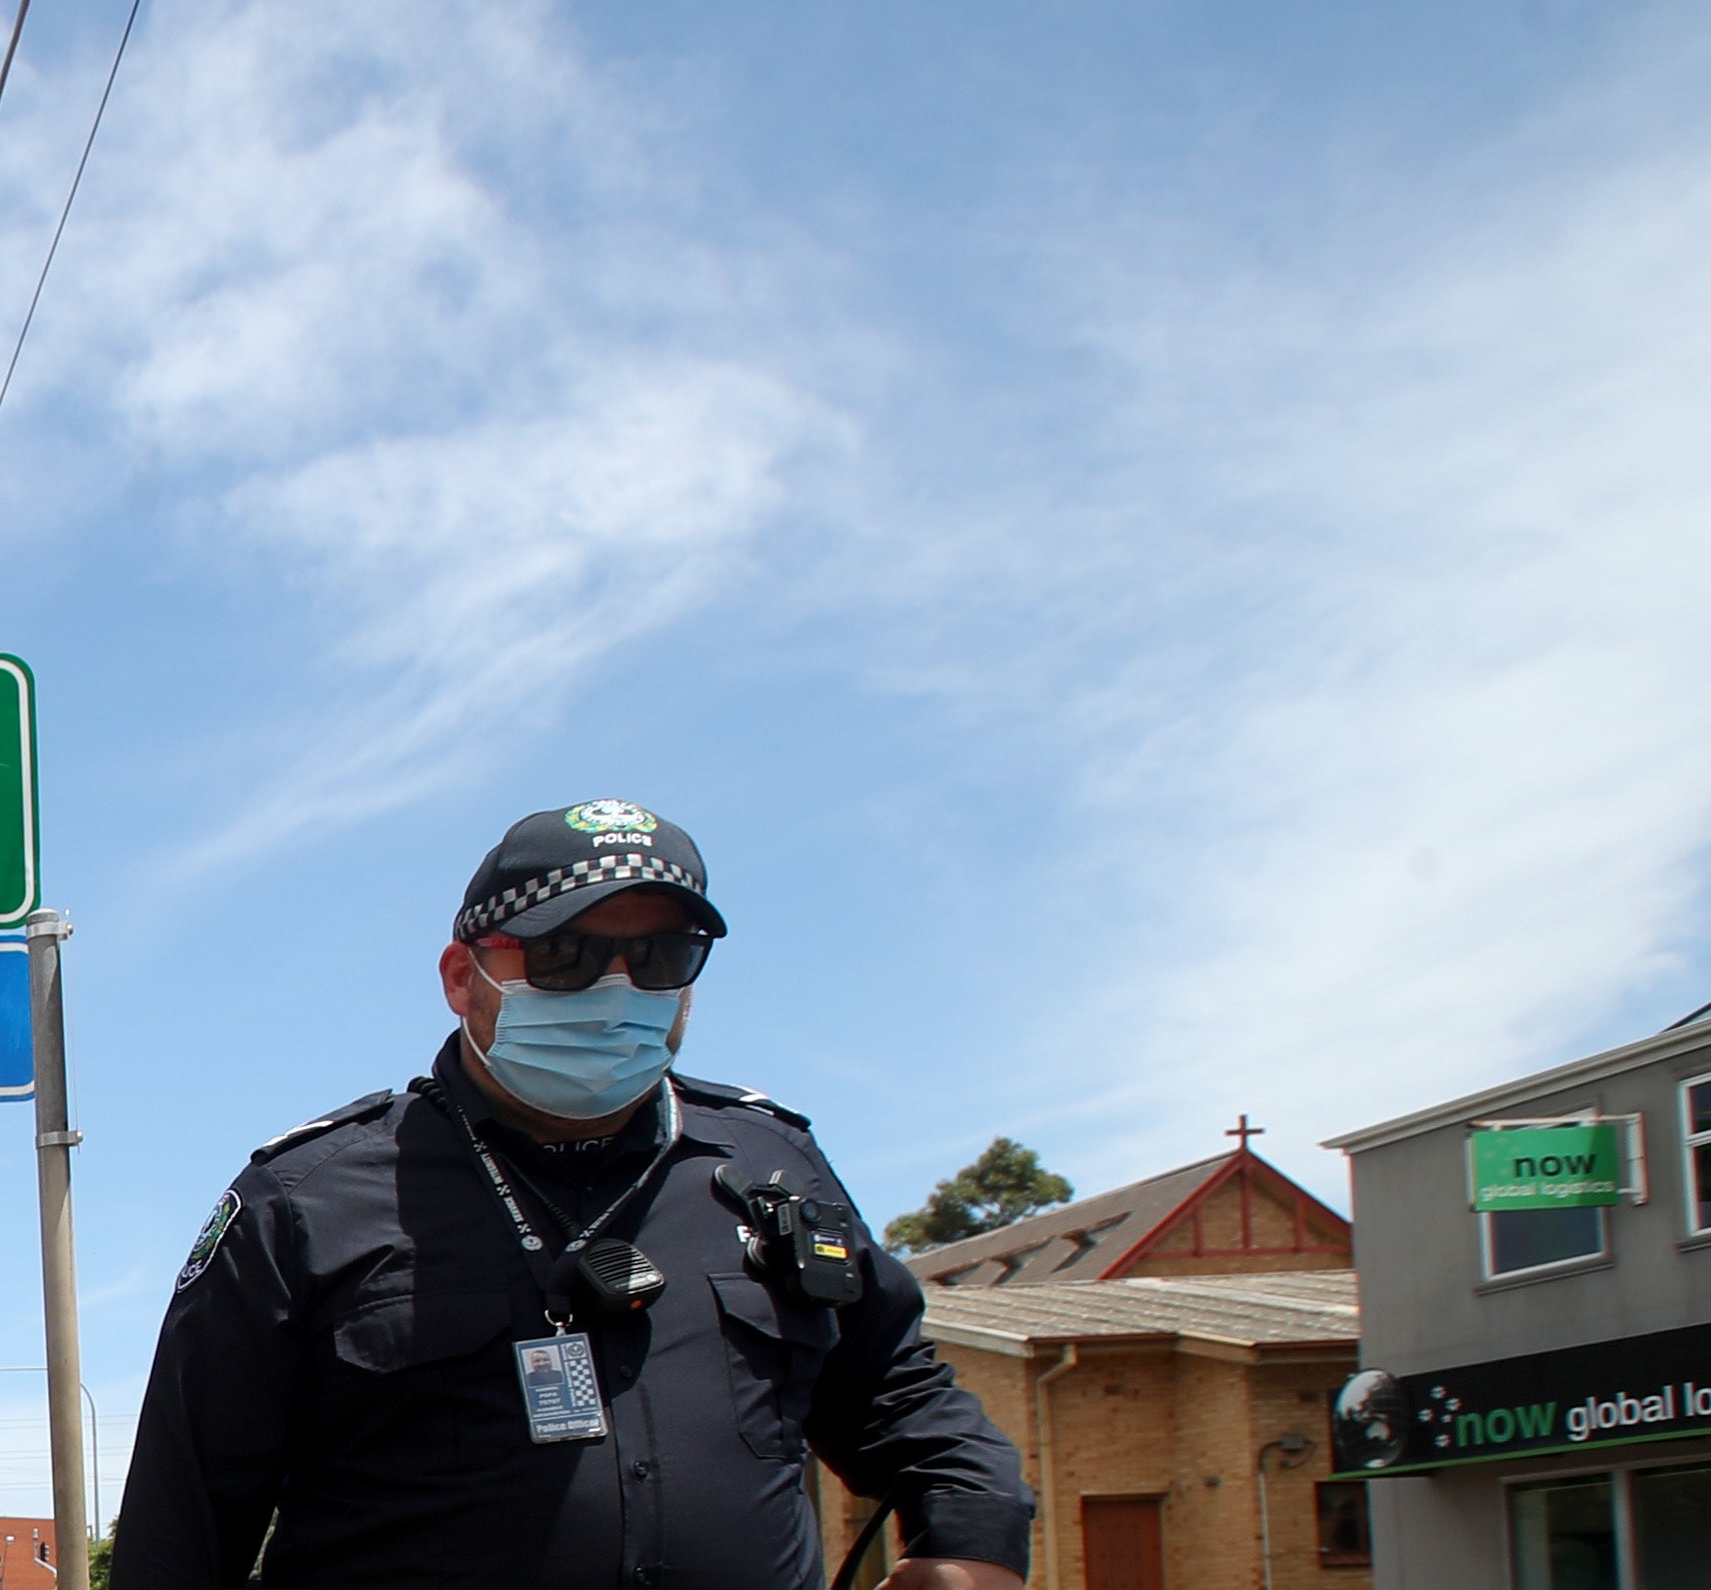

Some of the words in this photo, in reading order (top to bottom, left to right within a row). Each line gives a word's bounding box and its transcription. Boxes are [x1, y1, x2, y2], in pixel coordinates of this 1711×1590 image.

[592, 832, 653, 848] POLICE
[1514, 1153, 1597, 1178] now
[1481, 1182, 1537, 1201] global
[1542, 1180, 1616, 1198] logistics
[1455, 1402, 1557, 1447] now
[1566, 1384, 1678, 1442] global
